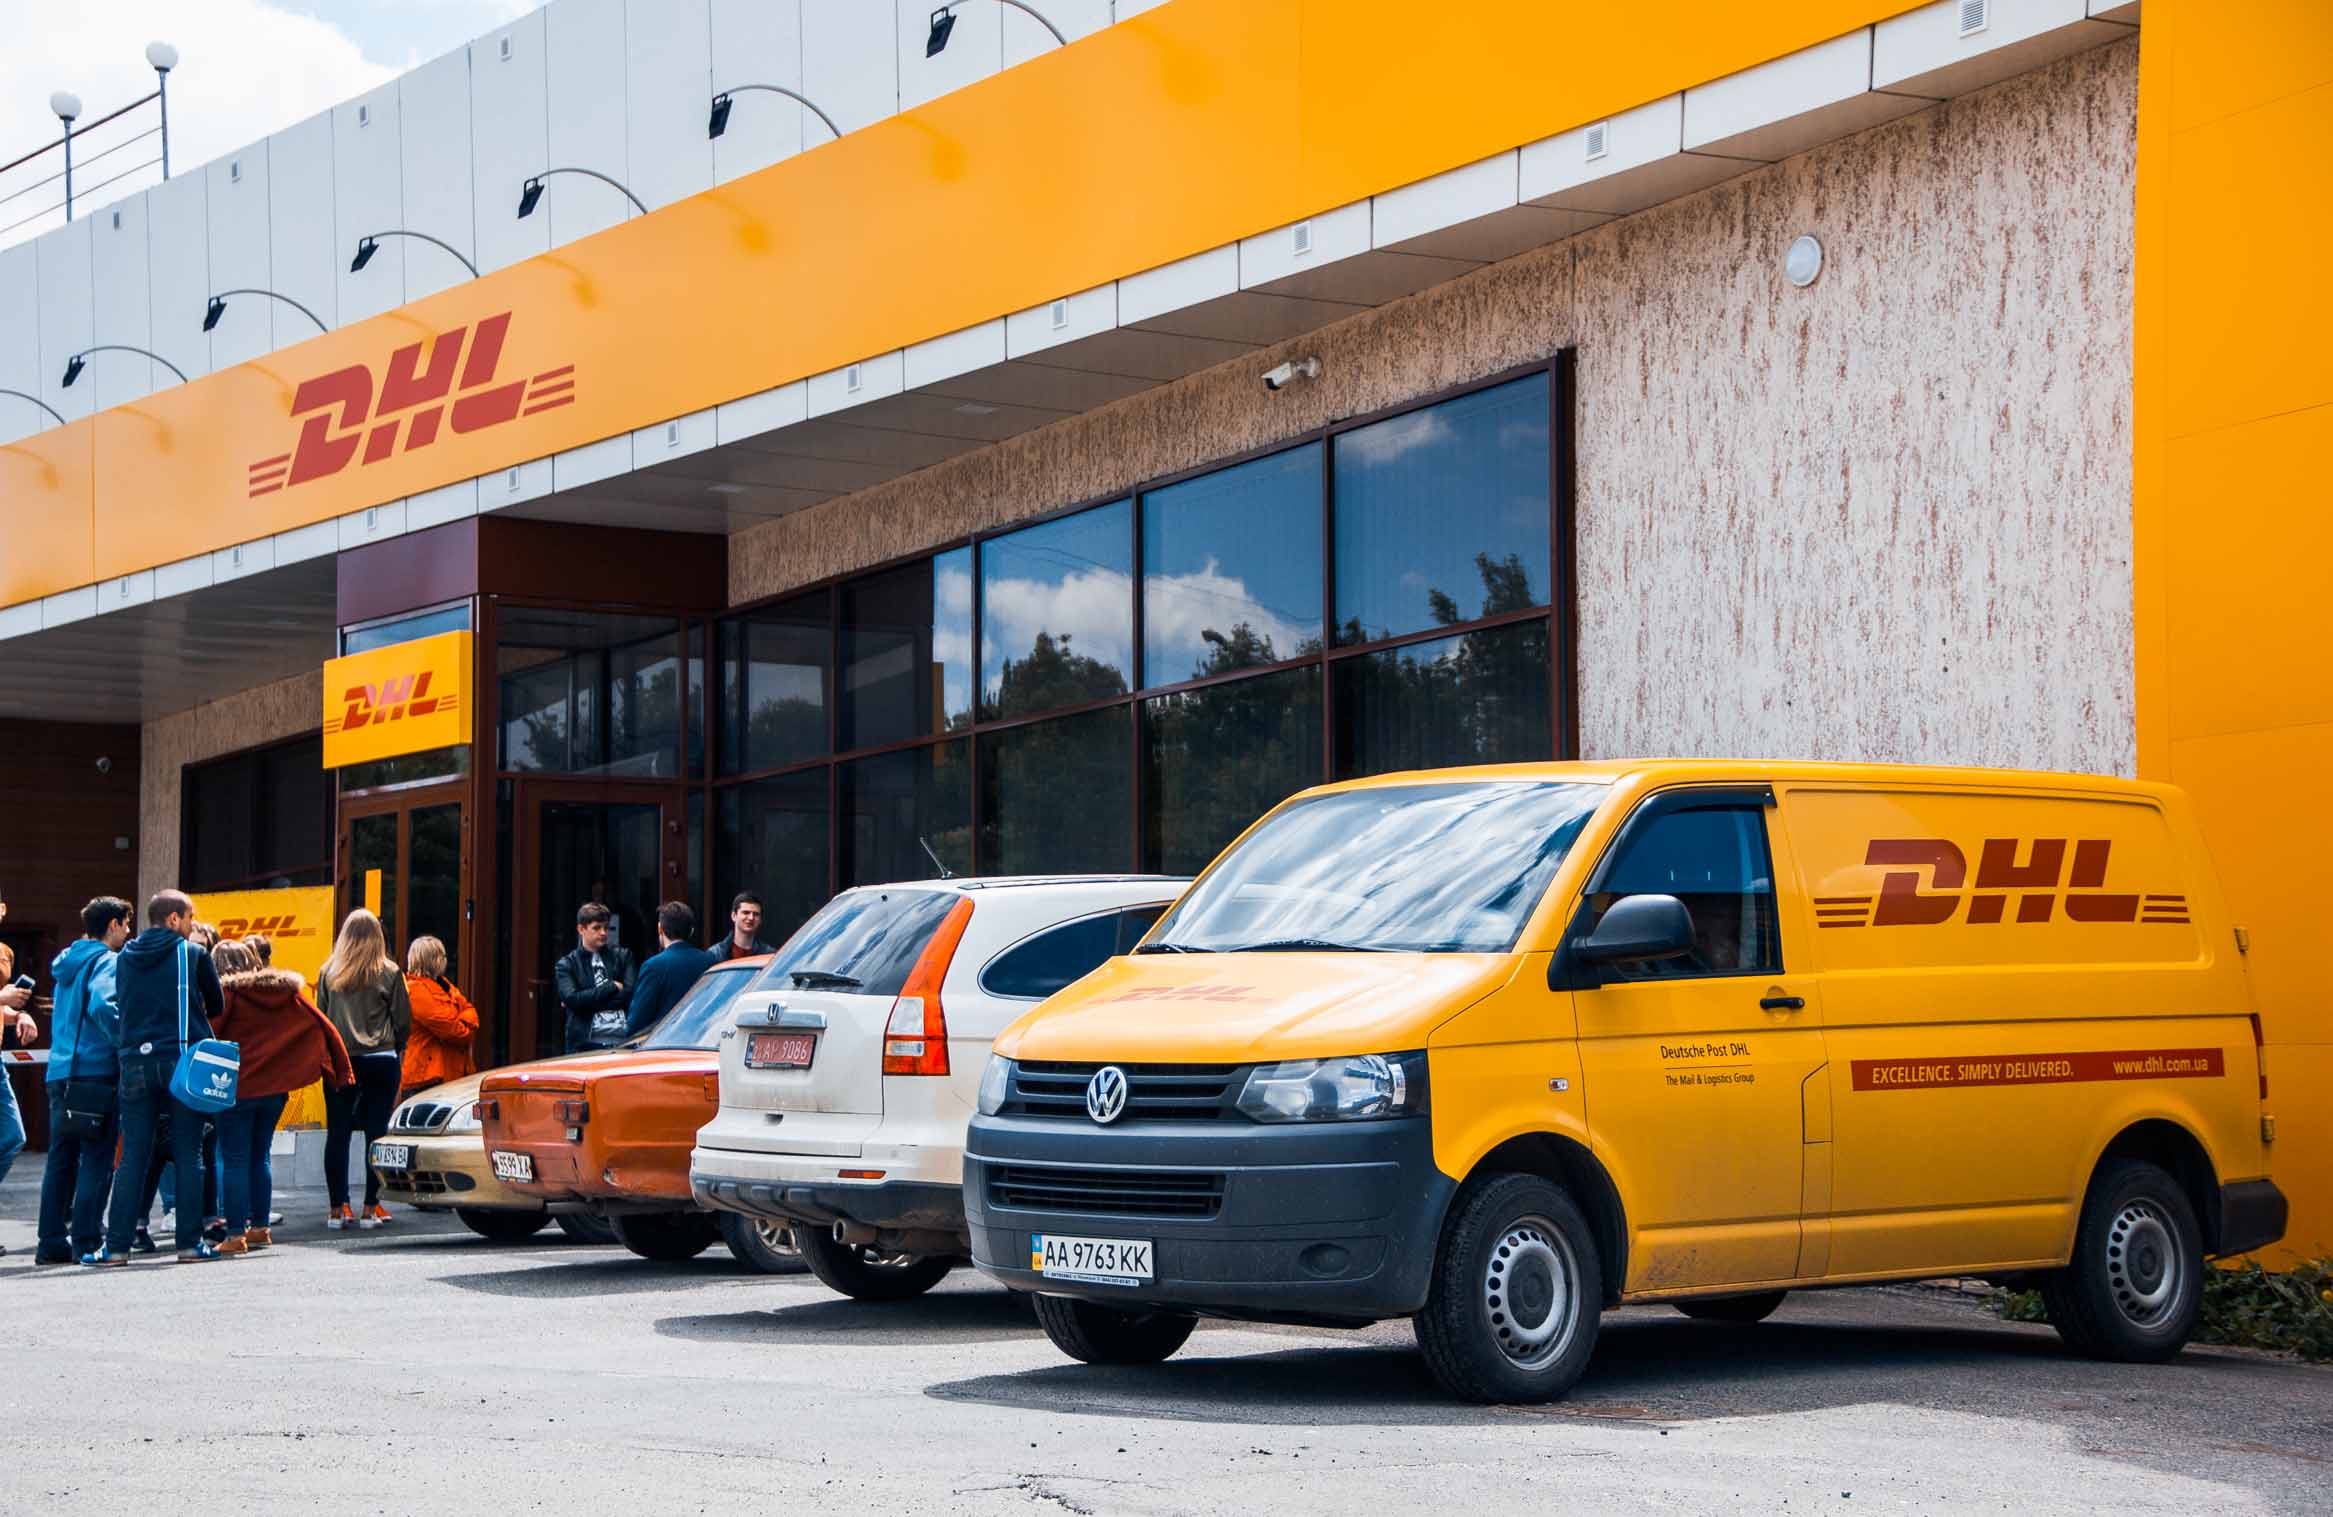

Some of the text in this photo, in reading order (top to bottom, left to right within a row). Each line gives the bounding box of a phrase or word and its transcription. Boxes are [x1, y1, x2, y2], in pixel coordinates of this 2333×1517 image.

[287, 311, 527, 487] DHL
[342, 671, 439, 731] DHL
[1864, 838, 2139, 927] DHL
[219, 915, 300, 940] DHL
[782, 1040, 809, 1060] 9086
[1660, 1042, 1751, 1059] Deutsche Post DHL
[1872, 1060, 2075, 1084] EXCELLENCE. SIMPLY DELIVERED.
[2112, 1055, 2209, 1075] www.dhl.com.ua
[1666, 1072, 1755, 1087] The Mail & Logistics Group
[1044, 1240, 1148, 1273] AA 9763 KK
